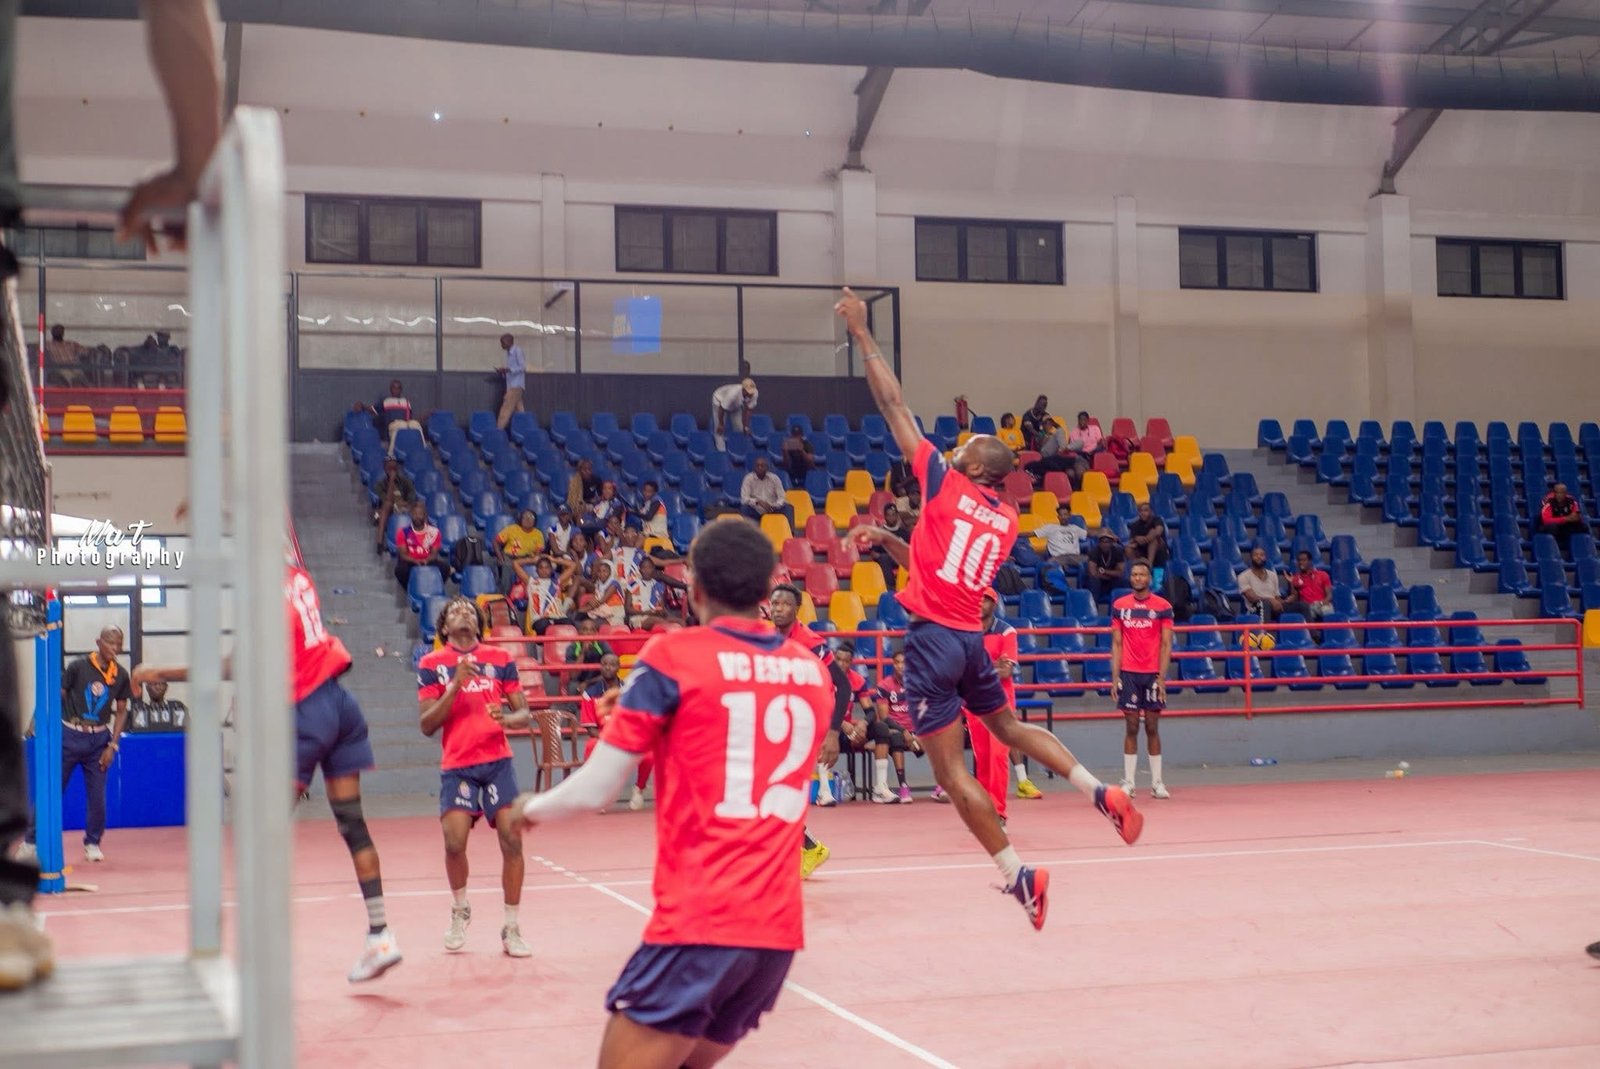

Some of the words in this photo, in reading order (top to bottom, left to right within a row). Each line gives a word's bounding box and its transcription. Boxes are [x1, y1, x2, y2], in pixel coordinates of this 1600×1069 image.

[936, 518, 1000, 592] 10
[436, 664, 450, 685] 3
[717, 651, 753, 682] VC
[889, 690, 898, 703] 8
[174, 709, 186, 727] 7
[714, 691, 816, 823] 12
[487, 783, 499, 806] 3
